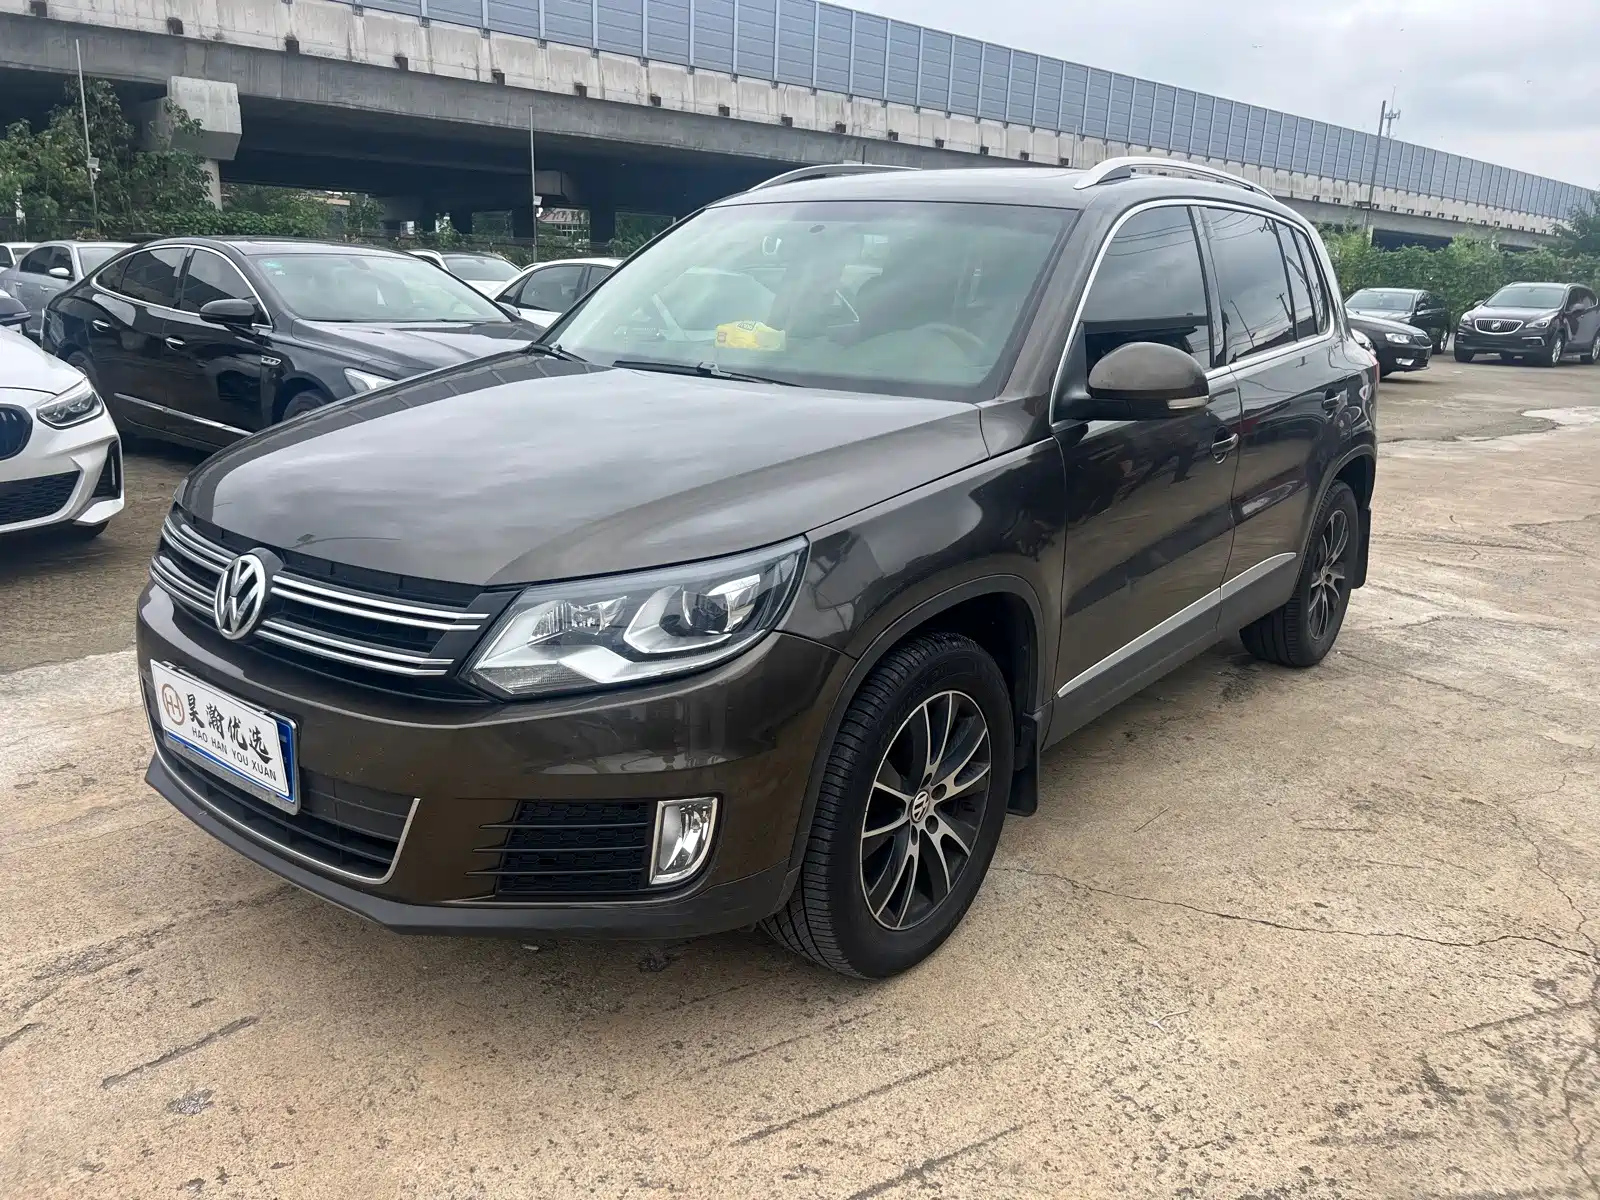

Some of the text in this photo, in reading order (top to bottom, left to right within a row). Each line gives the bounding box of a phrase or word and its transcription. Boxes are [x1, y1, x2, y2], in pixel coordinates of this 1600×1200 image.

[187, 693, 273, 764] 昊瀚优选
[191, 727, 277, 781] HAO HAN YOU XUAN
